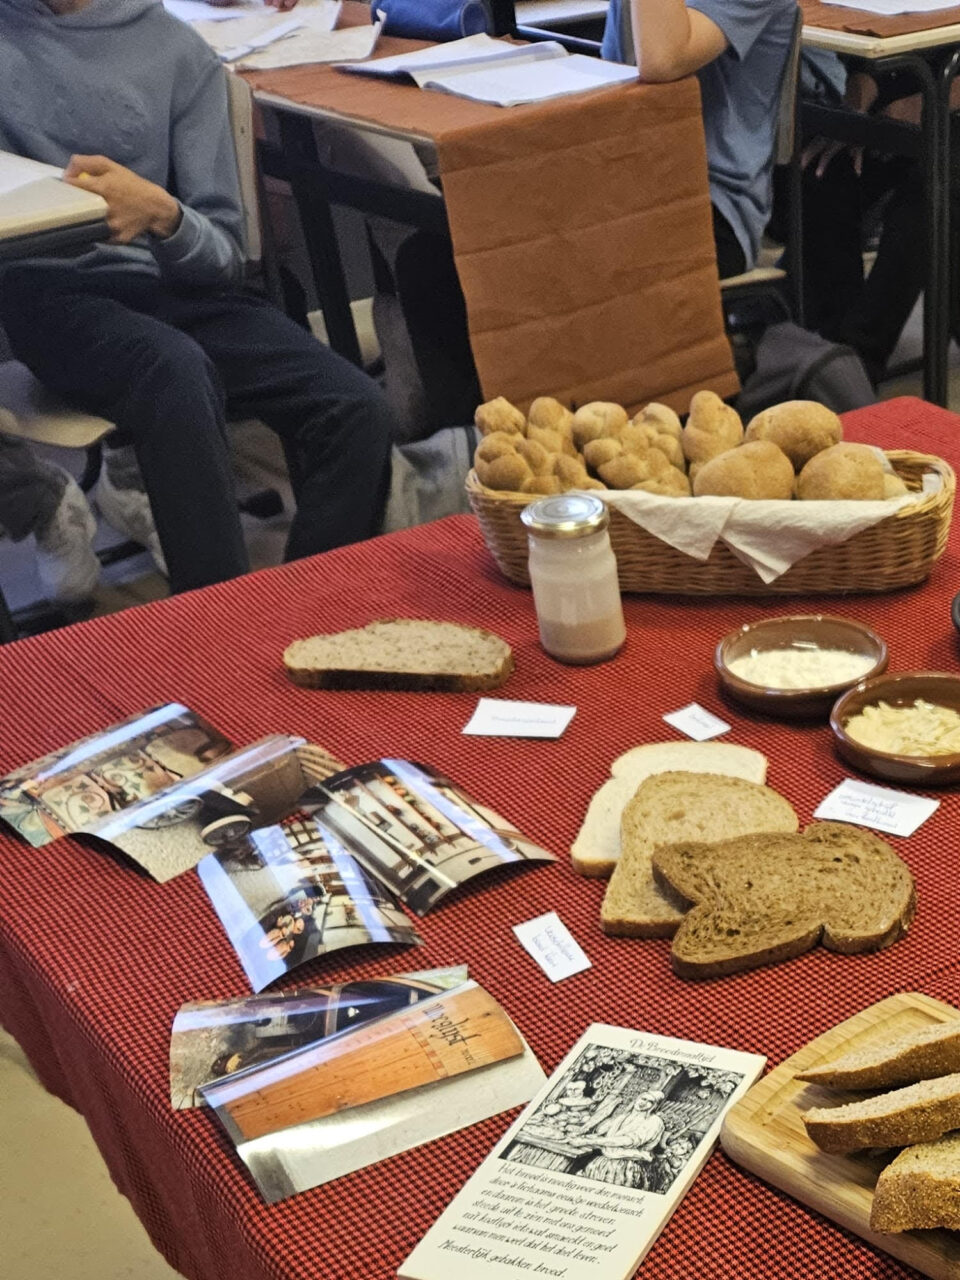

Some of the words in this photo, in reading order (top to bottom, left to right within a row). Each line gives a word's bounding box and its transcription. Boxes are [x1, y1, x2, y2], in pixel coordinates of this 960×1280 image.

[498, 1163, 517, 1175] Het
[515, 1168, 544, 1181] brood
[576, 1185, 596, 1193] voor
[487, 1254, 532, 1269] gebakken
